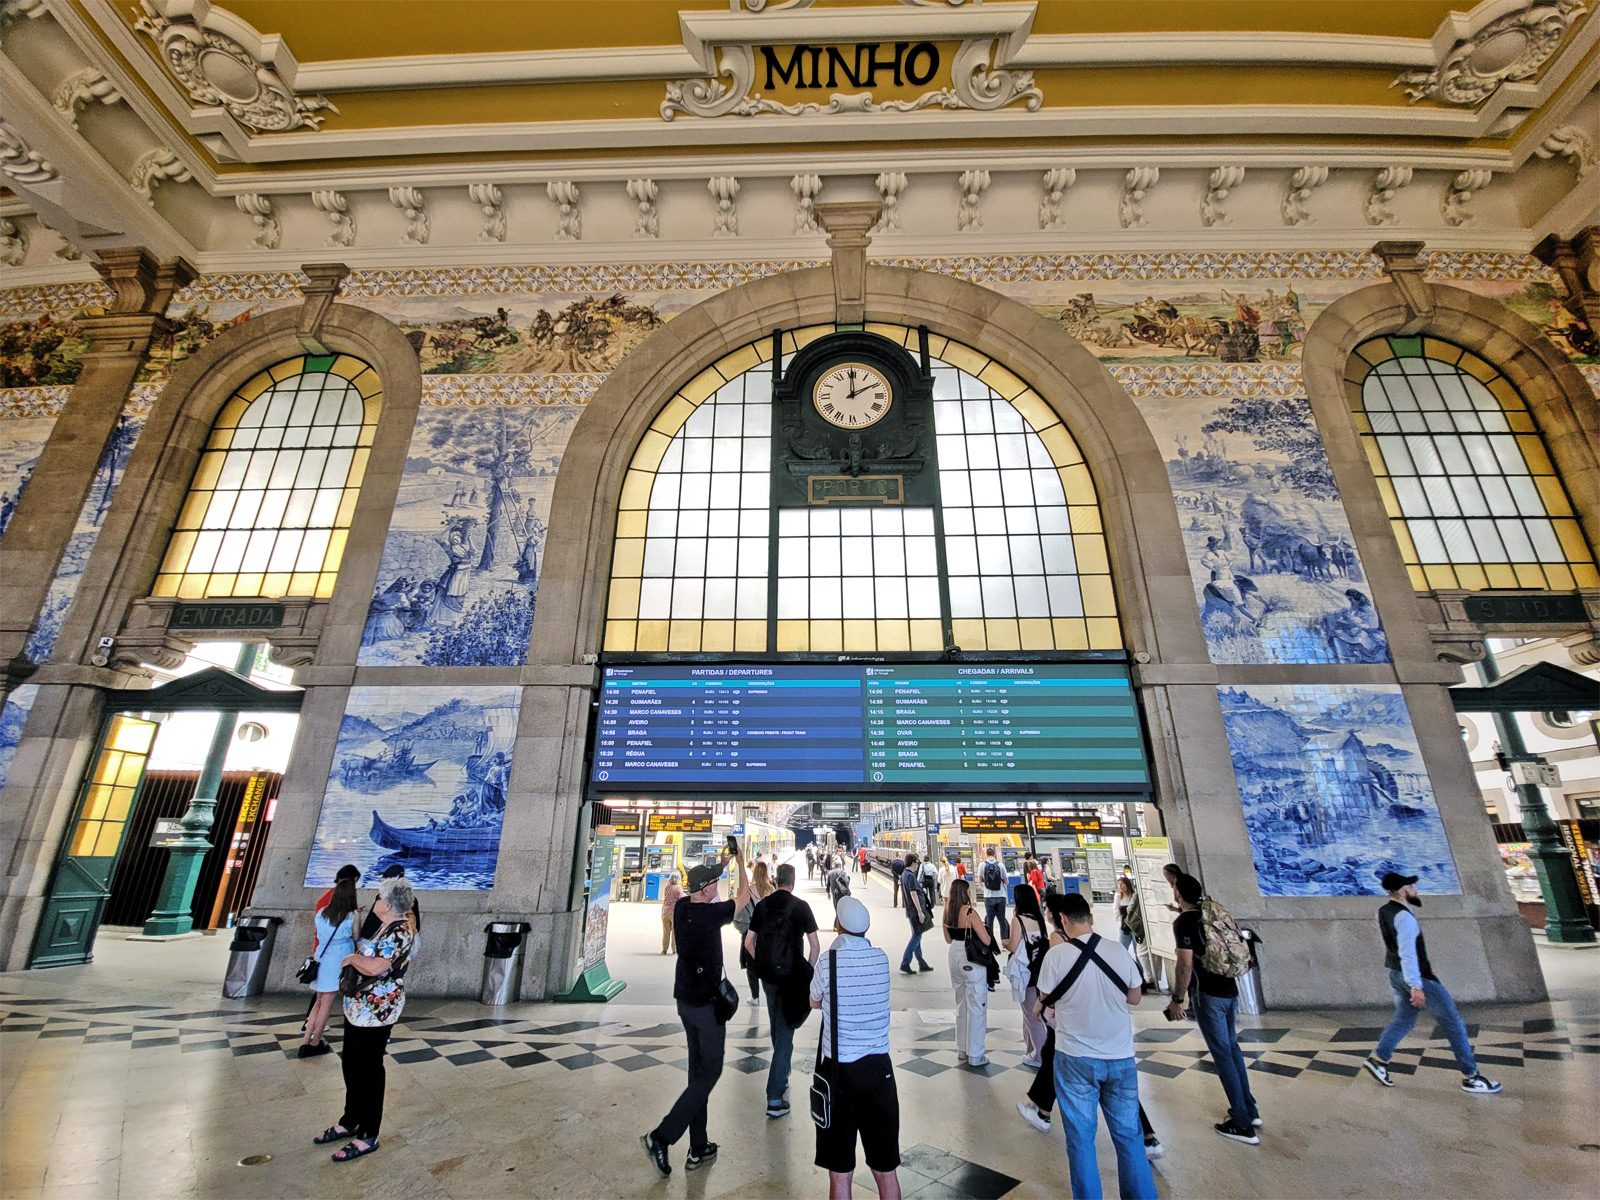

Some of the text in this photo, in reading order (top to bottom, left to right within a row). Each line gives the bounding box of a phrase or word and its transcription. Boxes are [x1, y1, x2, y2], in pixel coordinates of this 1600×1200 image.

[760, 41, 940, 90] MINHO
[178, 607, 274, 624] ENTRADA
[240, 776, 258, 822] EXCHANGE
[247, 777, 266, 822] EXCHANGE
[1571, 824, 1587, 859] SWEETS
[1561, 824, 1592, 905] REGIONAL SWEETS
